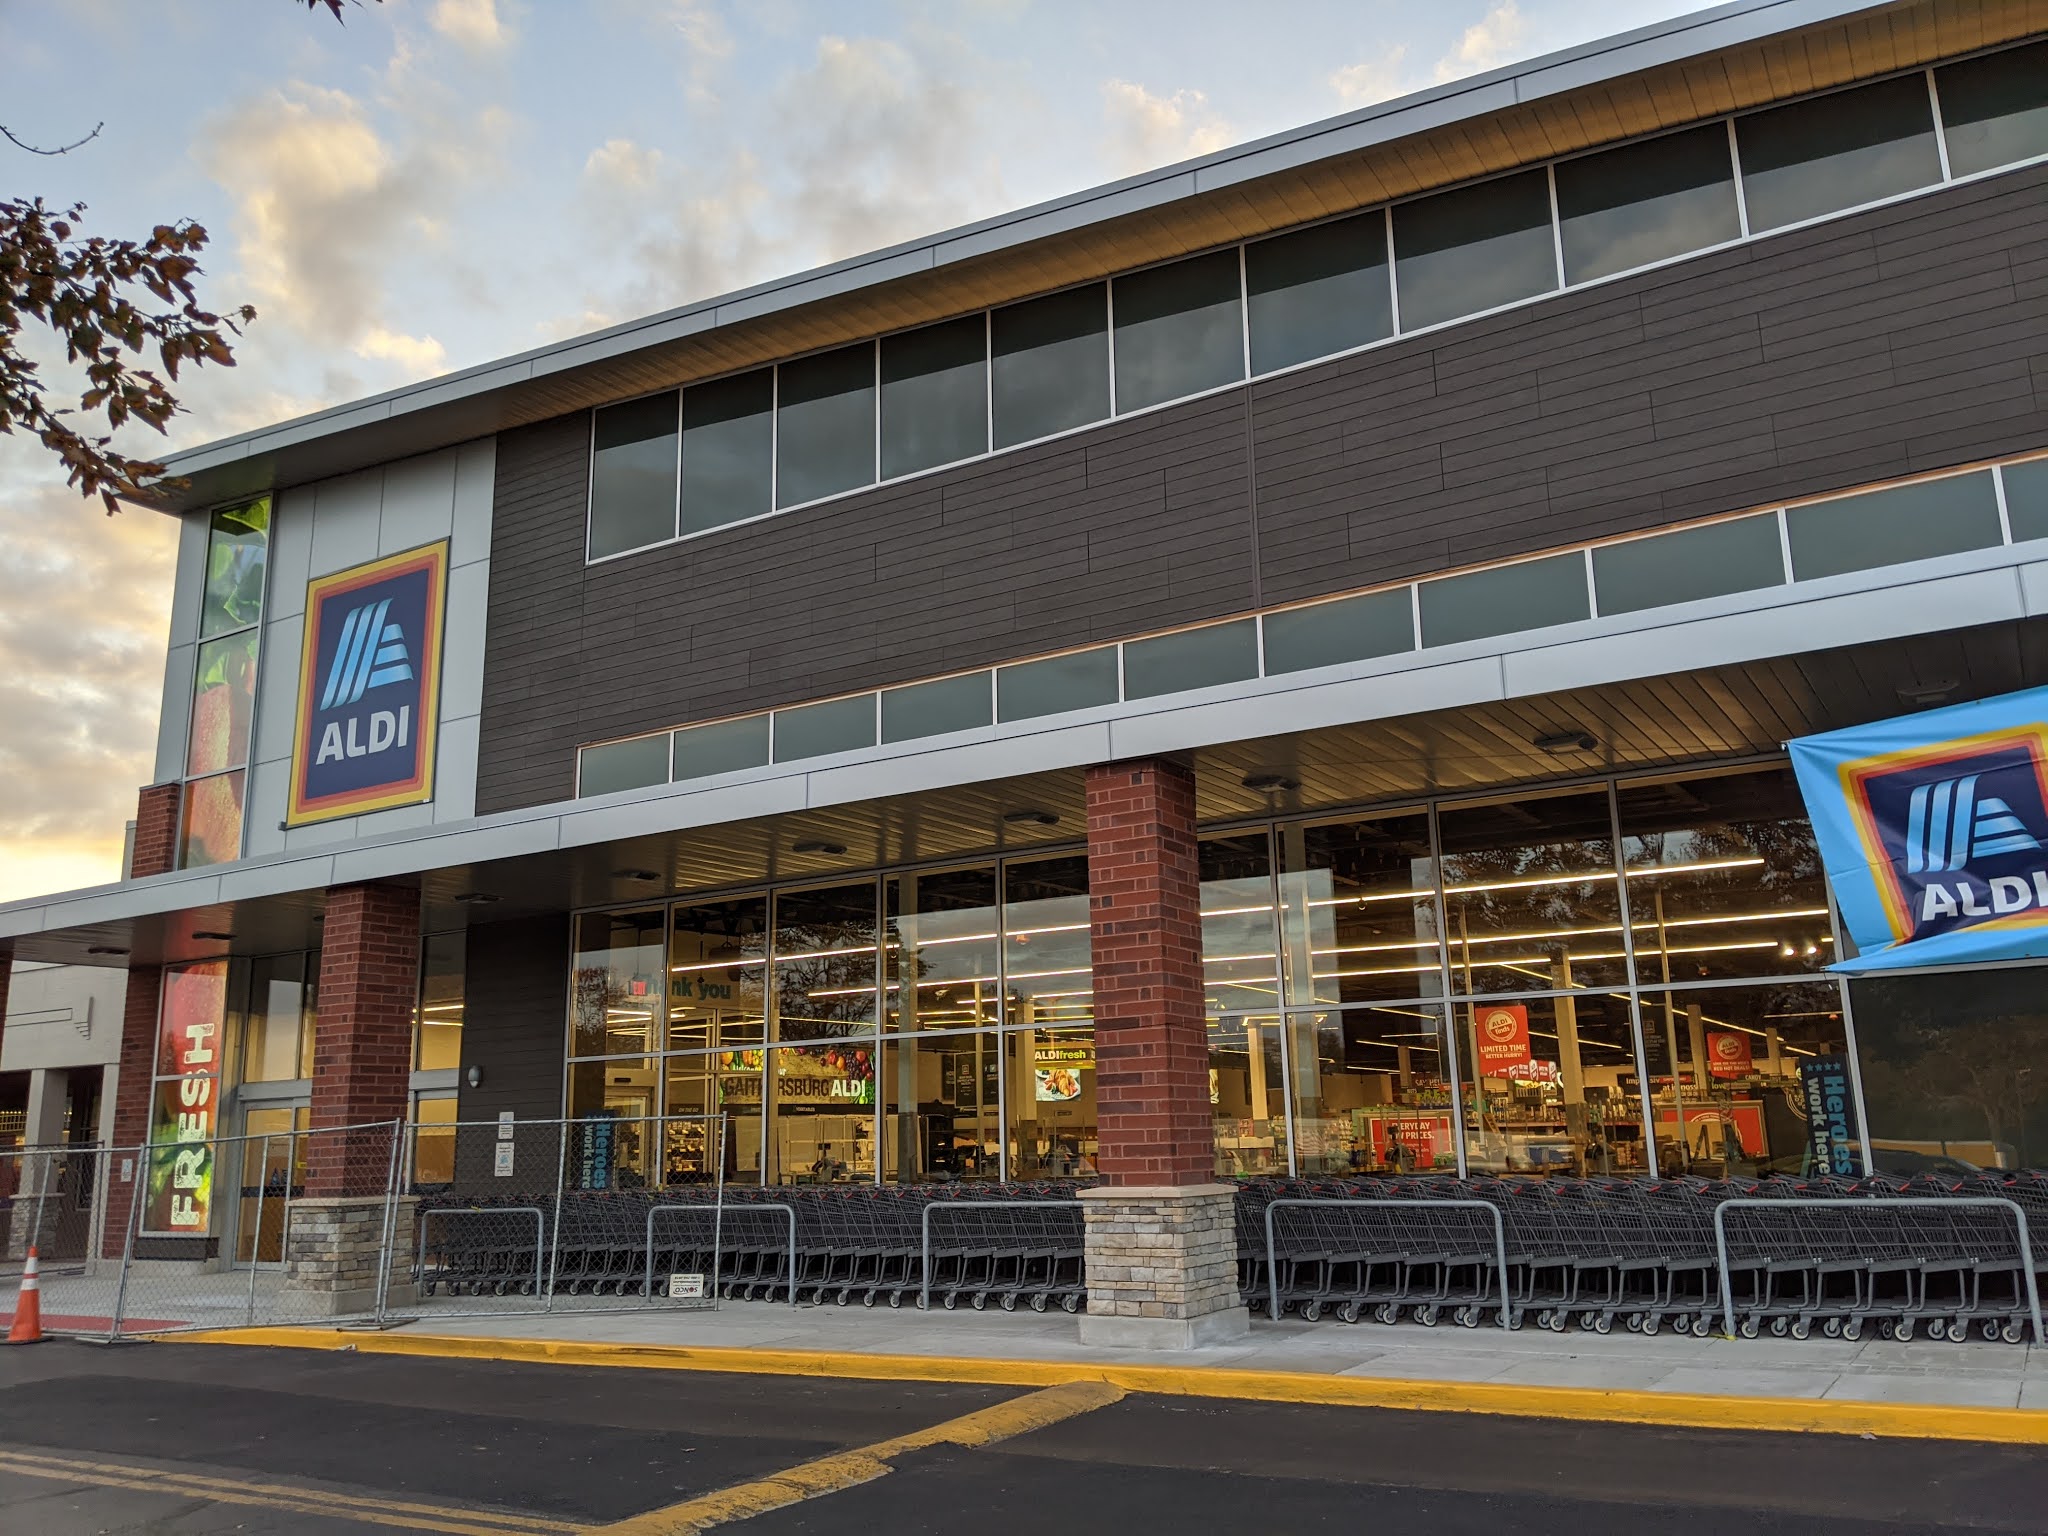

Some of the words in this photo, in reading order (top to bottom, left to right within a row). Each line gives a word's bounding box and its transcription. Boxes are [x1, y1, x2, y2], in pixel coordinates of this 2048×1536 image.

[316, 705, 410, 766] ALDI
[1921, 869, 2048, 922] ALDI
[697, 983, 731, 1001] you
[1492, 1018, 1508, 1027] ALDI
[1481, 1045, 1508, 1053] LIMITED
[1509, 1044, 1527, 1052] TIME
[724, 1077, 829, 1097] GAITRSBURG
[830, 1079, 866, 1098] ALDI
[1807, 1077, 1828, 1127] work
[170, 1023, 215, 1226] FRESH
[583, 1124, 595, 1158] work
[1391, 1121, 1431, 1131] ERYAY
[1824, 1075, 1852, 1175] Heroes
[594, 1122, 611, 1189] Heroes
[1814, 1130, 1831, 1175] here
[582, 1160, 594, 1189] here
